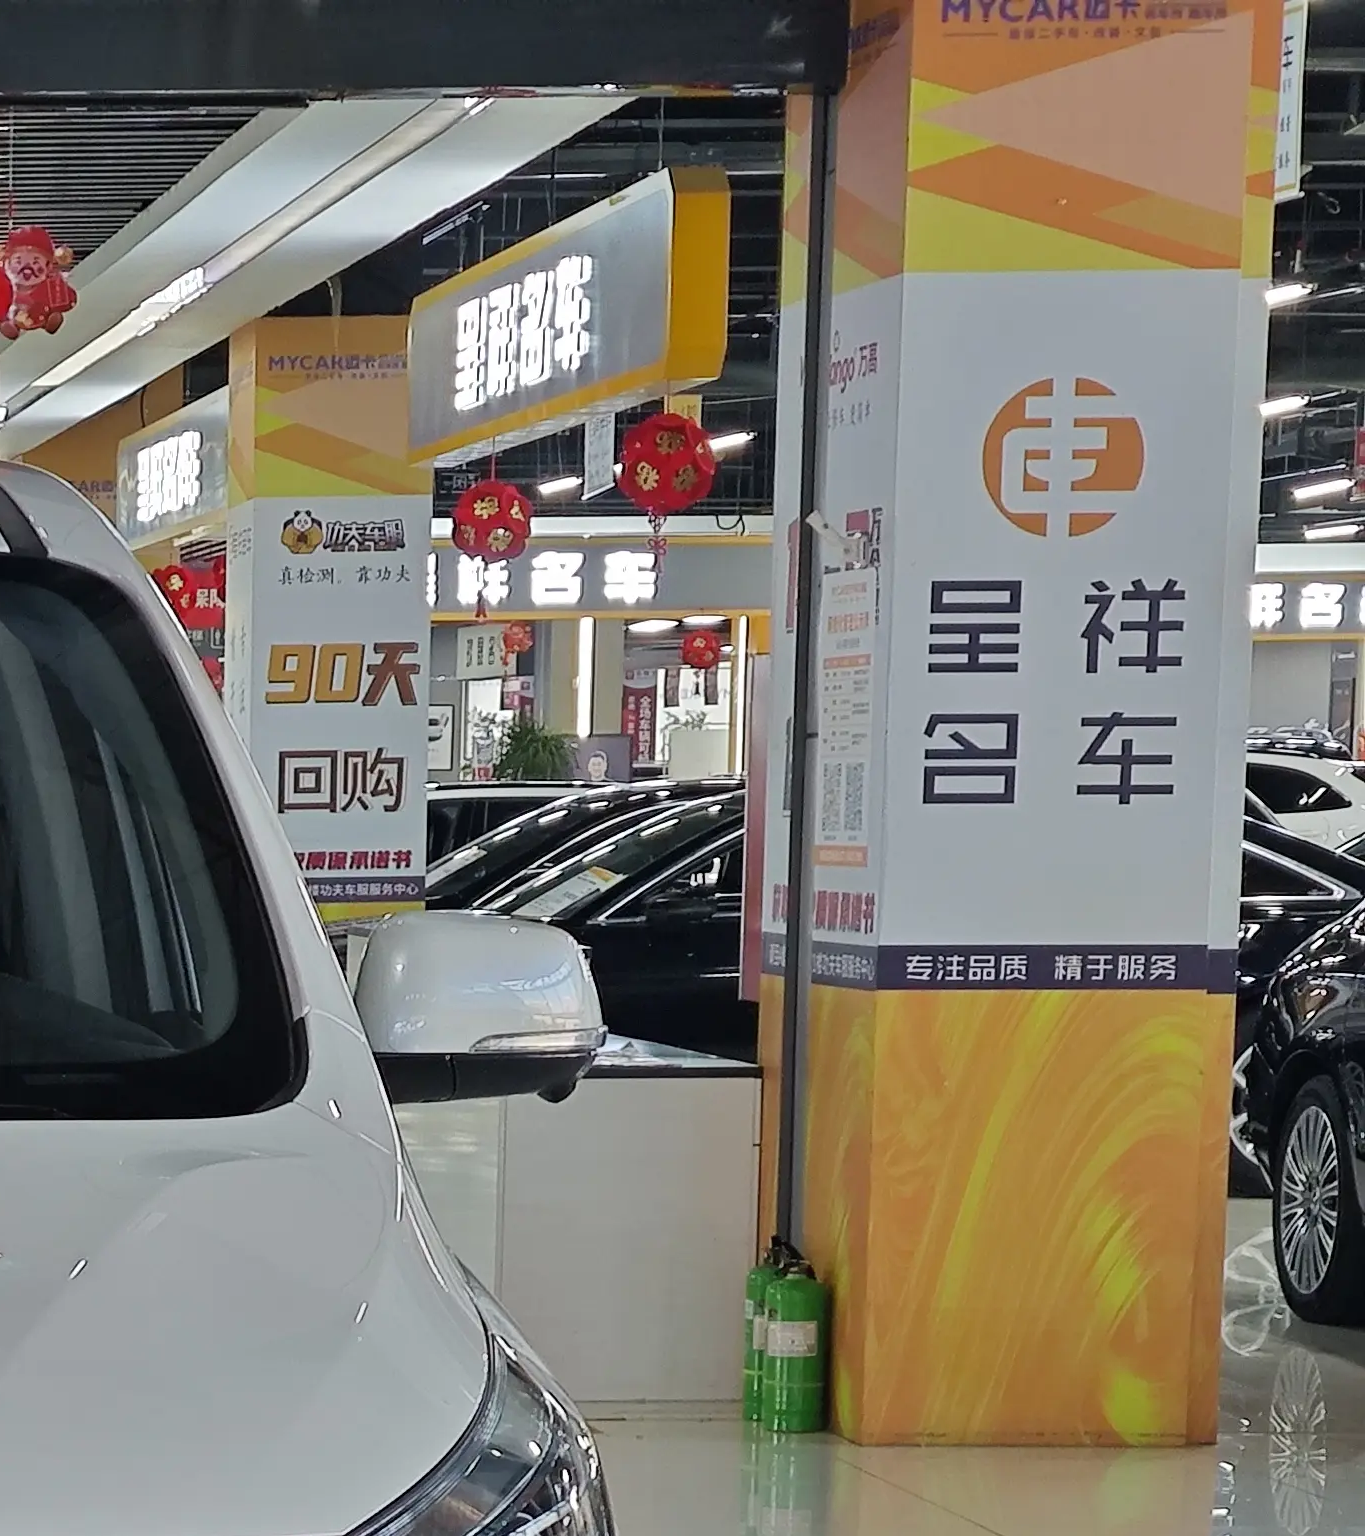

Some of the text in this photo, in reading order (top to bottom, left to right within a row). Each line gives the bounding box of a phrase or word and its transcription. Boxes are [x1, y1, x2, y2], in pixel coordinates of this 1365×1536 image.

[455, 255, 592, 411] 呈祥名车
[326, 519, 405, 547] 功夫车服
[426, 551, 657, 606] 祥名车
[928, 578, 1186, 674] 呈祥
[265, 642, 420, 706] 90天
[277, 748, 407, 813] 回购
[922, 712, 1178, 805] 名车
[906, 953, 1177, 982] 专注品质 精于服务
